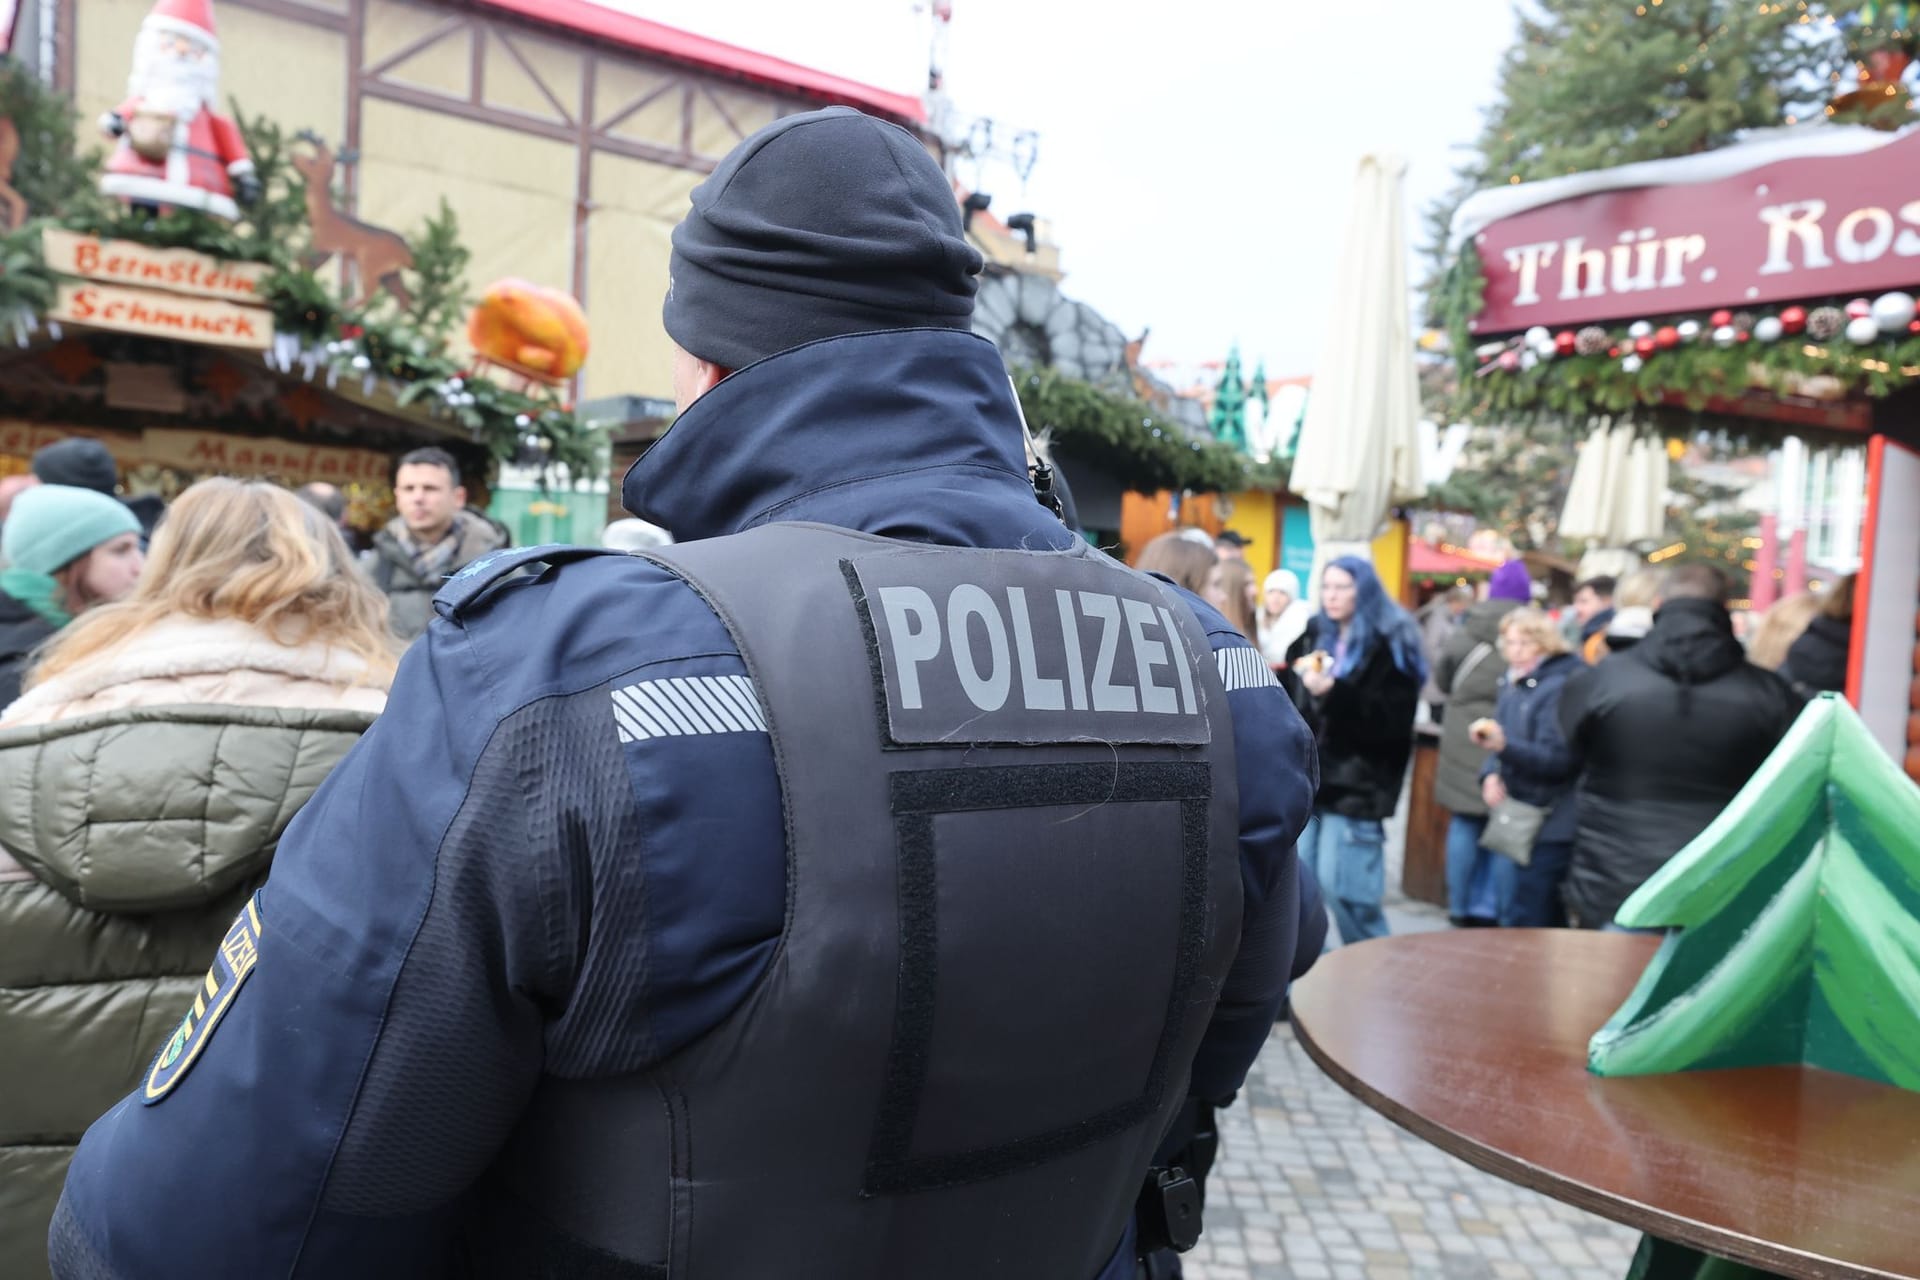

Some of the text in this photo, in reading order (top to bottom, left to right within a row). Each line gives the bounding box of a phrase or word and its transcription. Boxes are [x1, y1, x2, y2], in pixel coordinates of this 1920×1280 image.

[1503, 227, 1718, 306] Thür.
[72, 285, 254, 337] Schmuck
[878, 583, 1198, 715] POLIZEI
